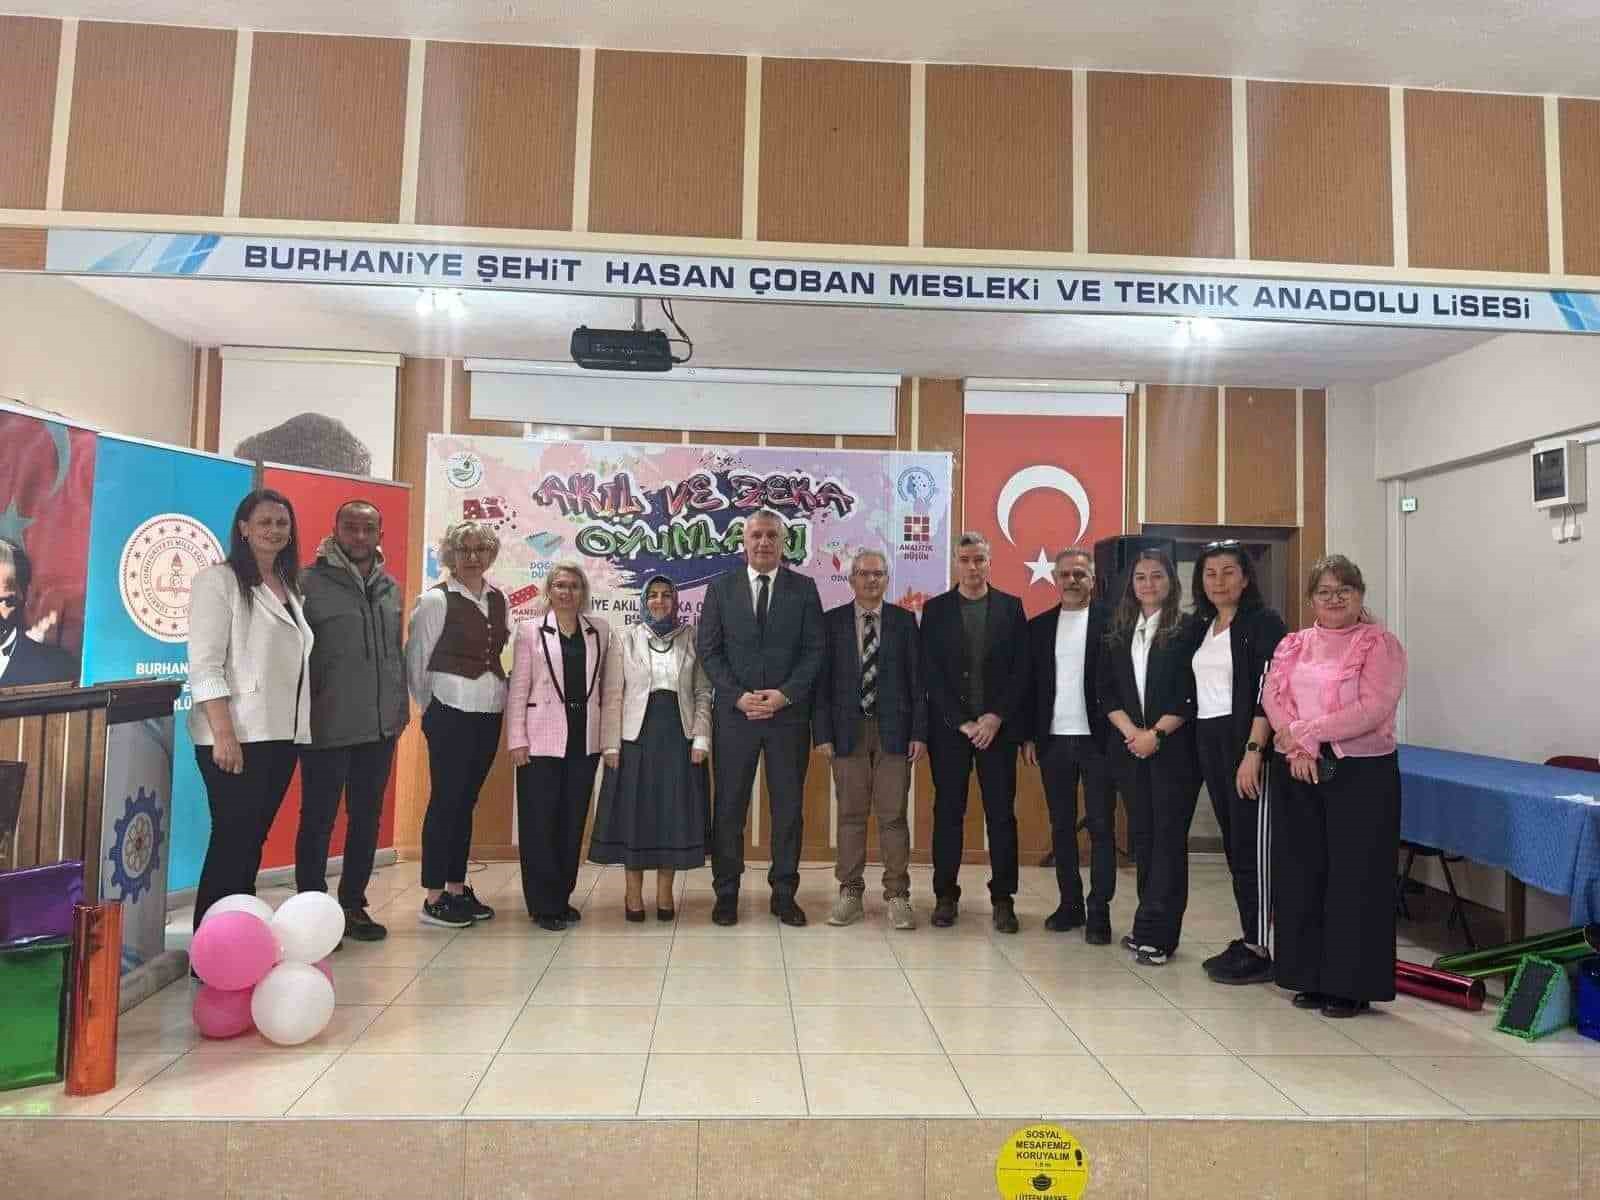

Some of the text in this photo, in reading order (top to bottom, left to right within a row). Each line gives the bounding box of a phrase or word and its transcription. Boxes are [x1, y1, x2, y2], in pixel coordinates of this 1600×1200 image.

[606, 261, 734, 289] HASAN
[750, 268, 875, 295] ÇOBAN
[1056, 279, 1101, 302] VE
[1253, 286, 1419, 315] ANADOLU
[1026, 1130, 1061, 1139] SOSYAL
[1016, 1151, 1070, 1161] KORUYALIM
